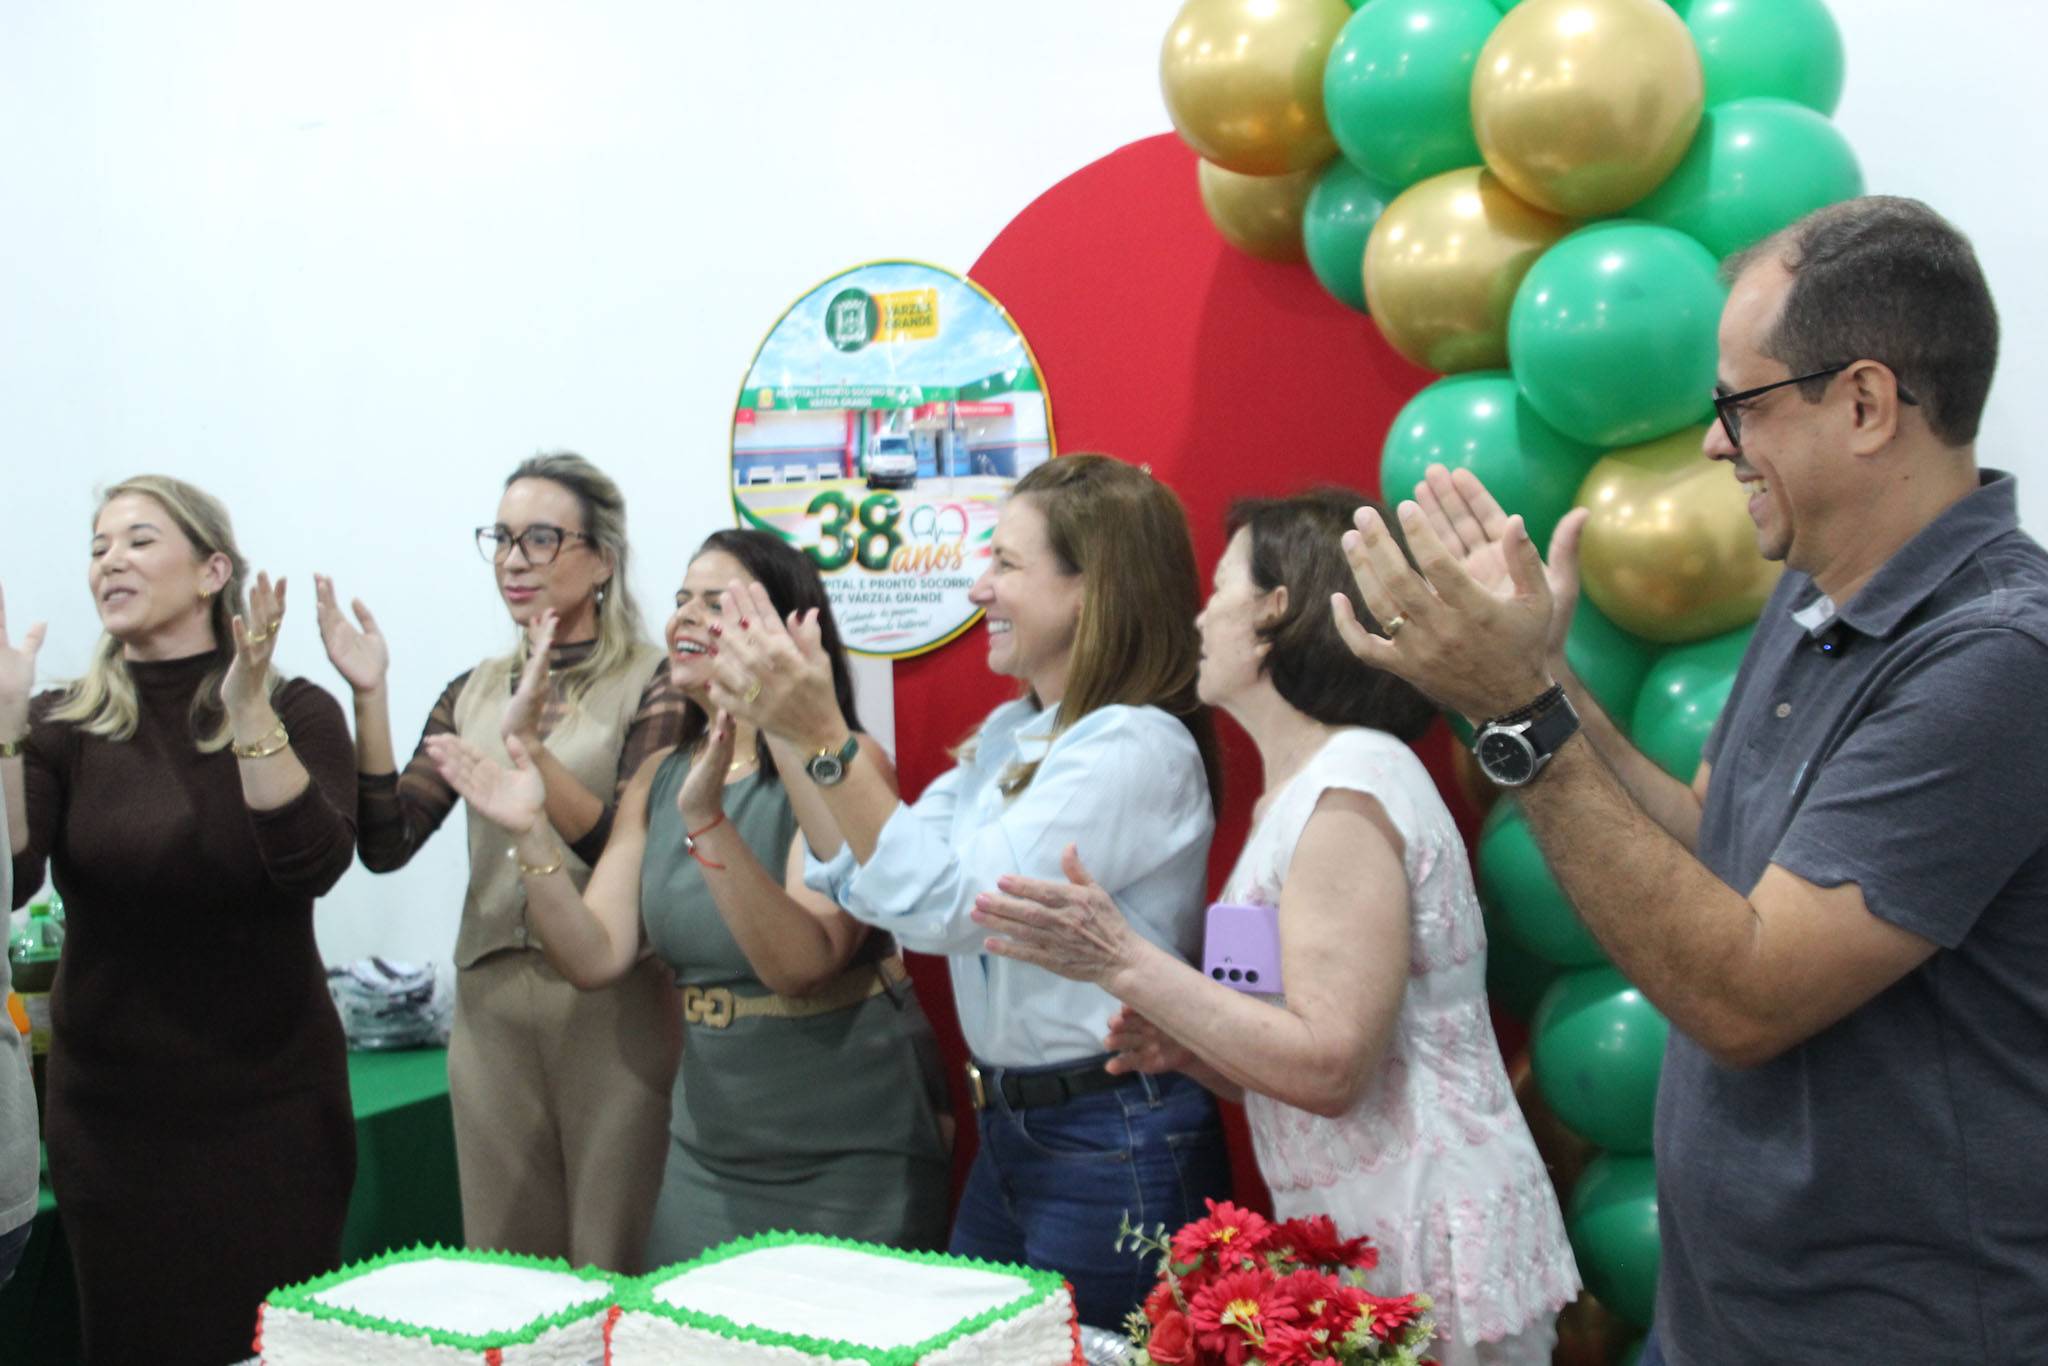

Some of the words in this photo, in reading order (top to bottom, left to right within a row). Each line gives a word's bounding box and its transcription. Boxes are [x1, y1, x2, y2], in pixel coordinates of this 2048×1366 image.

[803, 489, 903, 573] 38
[891, 542, 967, 574] anos
[859, 579, 866, 589] E
[870, 578, 917, 589] PRONTO
[920, 578, 974, 589] SOCORRO
[895, 592, 943, 603] GRANDE
